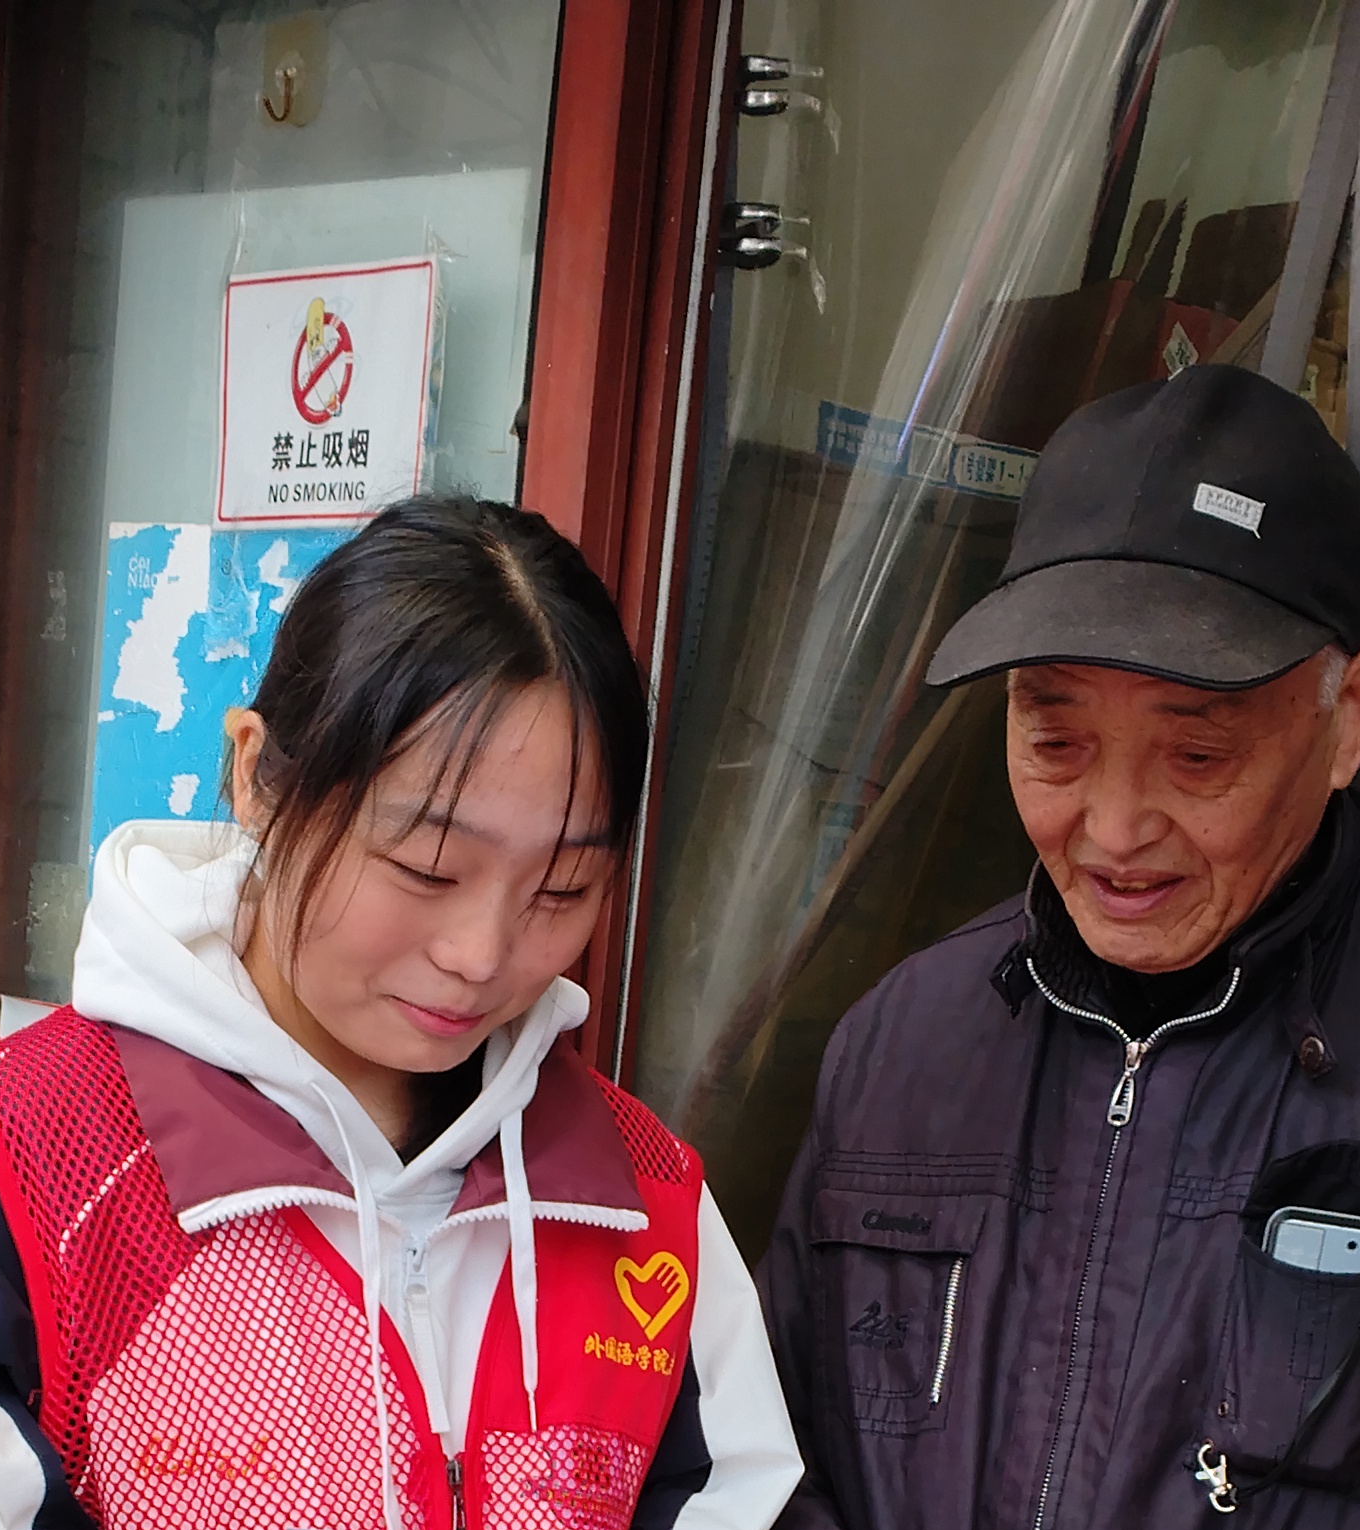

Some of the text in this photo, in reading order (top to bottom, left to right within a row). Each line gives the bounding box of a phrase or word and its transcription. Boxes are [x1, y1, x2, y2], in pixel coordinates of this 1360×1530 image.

[271, 428, 370, 471] 禁止吸烟
[267, 481, 366, 503] NO SMOKING
